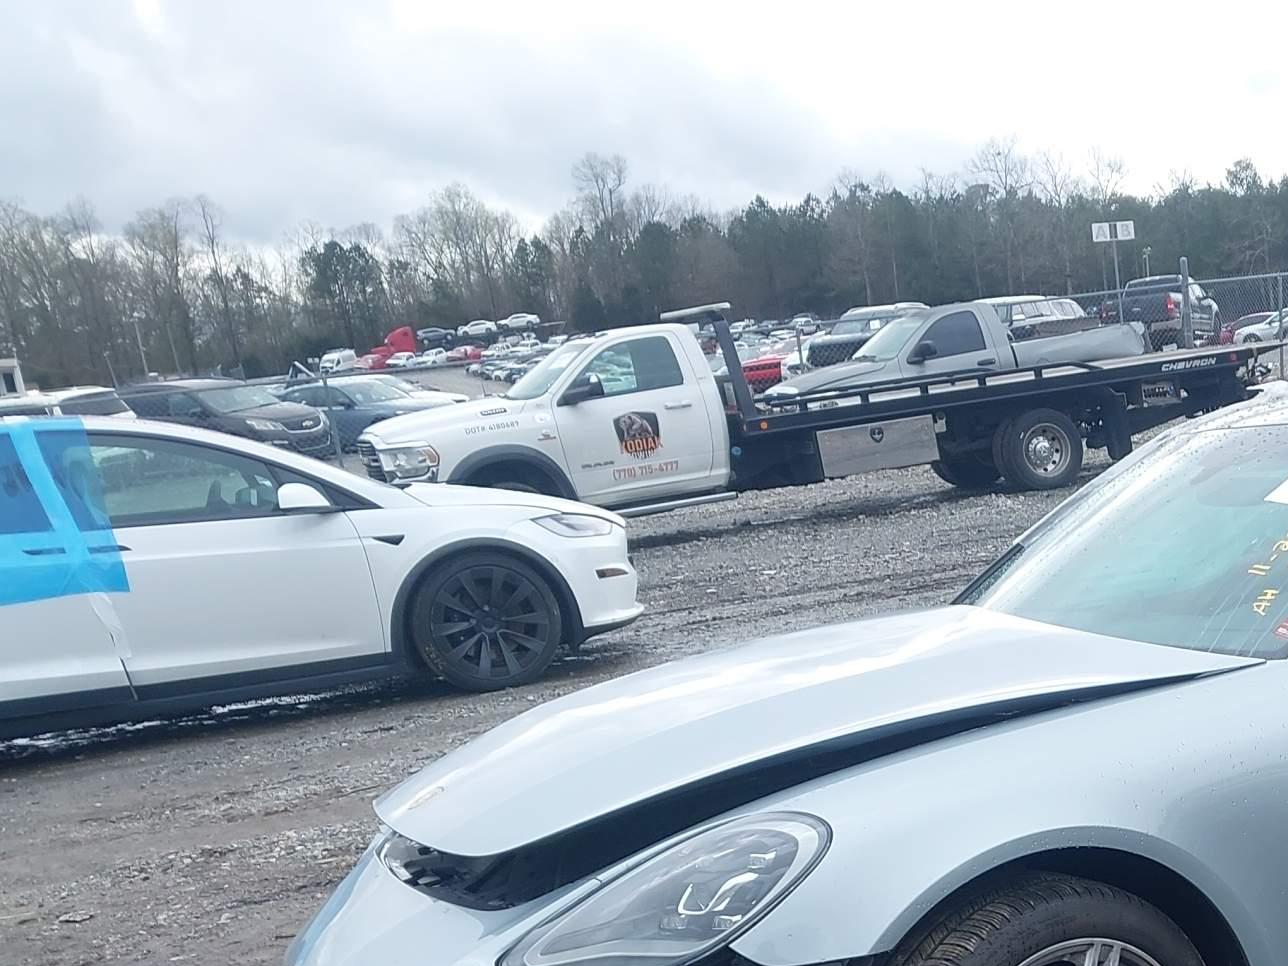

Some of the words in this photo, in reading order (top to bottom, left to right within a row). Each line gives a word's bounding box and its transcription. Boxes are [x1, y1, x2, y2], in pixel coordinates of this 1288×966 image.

[1095, 225, 1108, 240] A
[1120, 223, 1131, 238] B
[1161, 357, 1217, 372] CHEVRON
[619, 435, 664, 455] KODIAK
